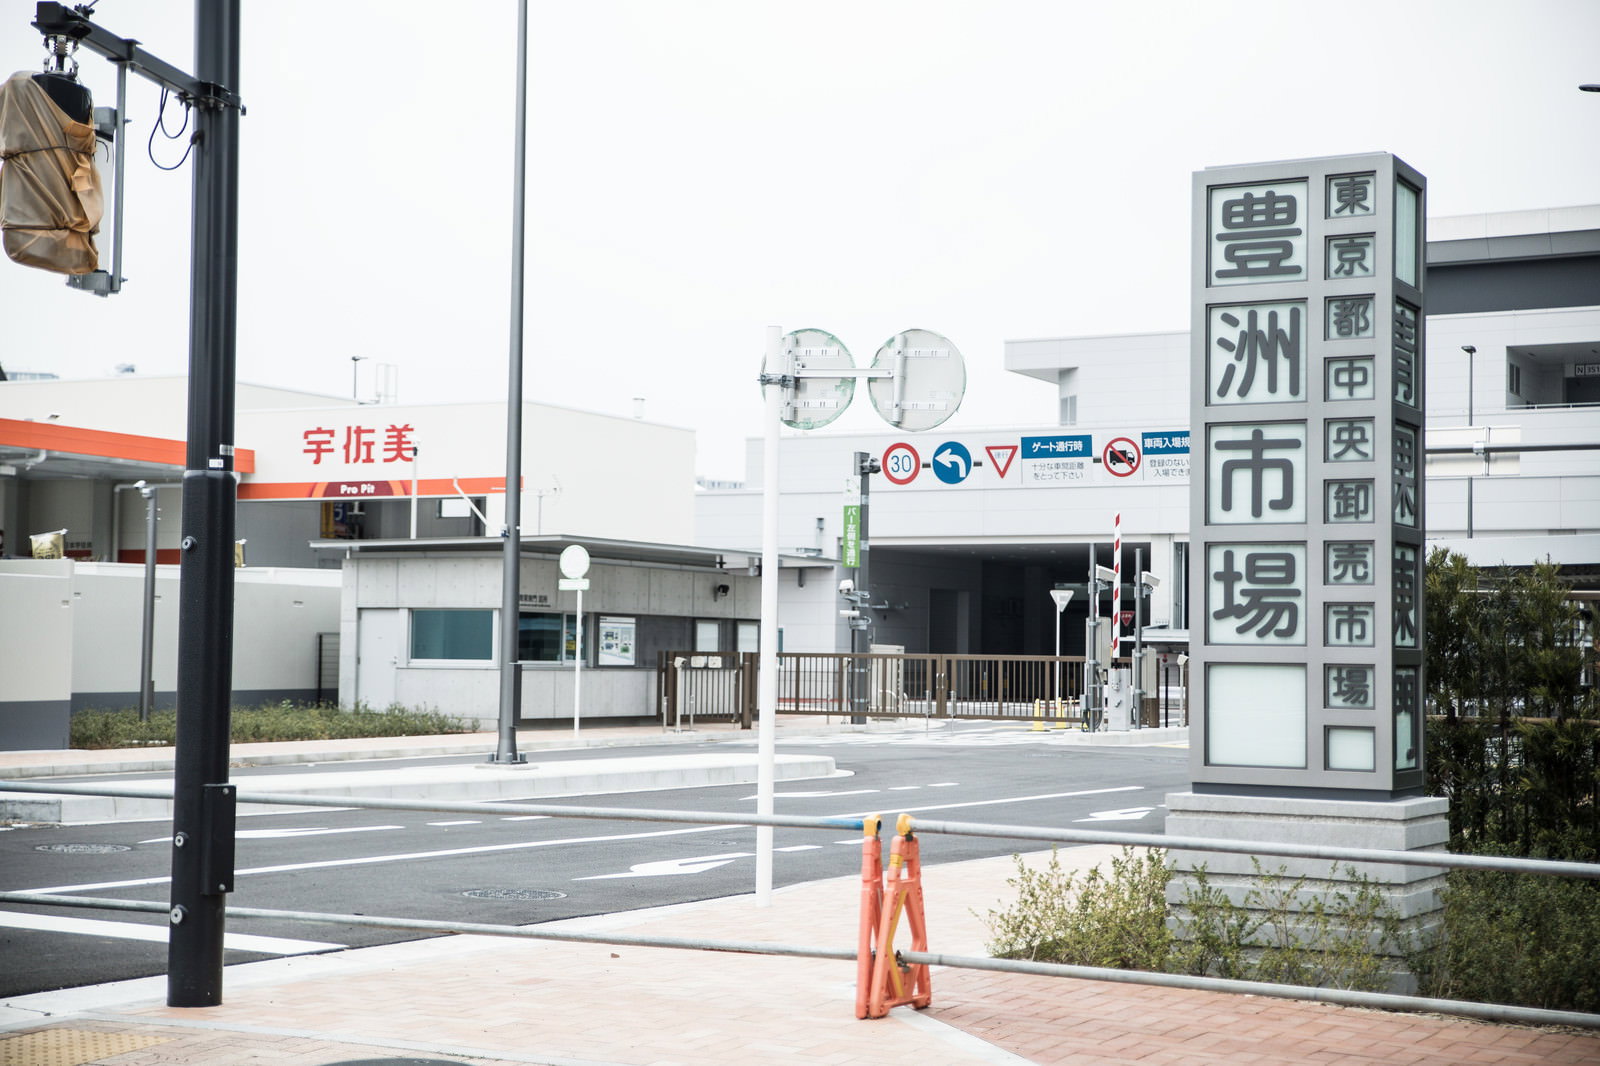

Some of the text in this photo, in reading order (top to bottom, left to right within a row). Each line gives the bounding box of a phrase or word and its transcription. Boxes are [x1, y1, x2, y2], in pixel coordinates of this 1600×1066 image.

[1213, 190, 1303, 639] 豊洲市場
[303, 424, 415, 465] 宇佐美
[1032, 440, 1083, 453] ゲート通行時
[1332, 177, 1371, 706] 東京都中央卸売市場
[890, 454, 912, 473] 30
[1032, 462, 1084, 471] 十分な車間距離
[1033, 471, 1083, 481] をとって下さい
[340, 483, 376, 495] Pro Pit
